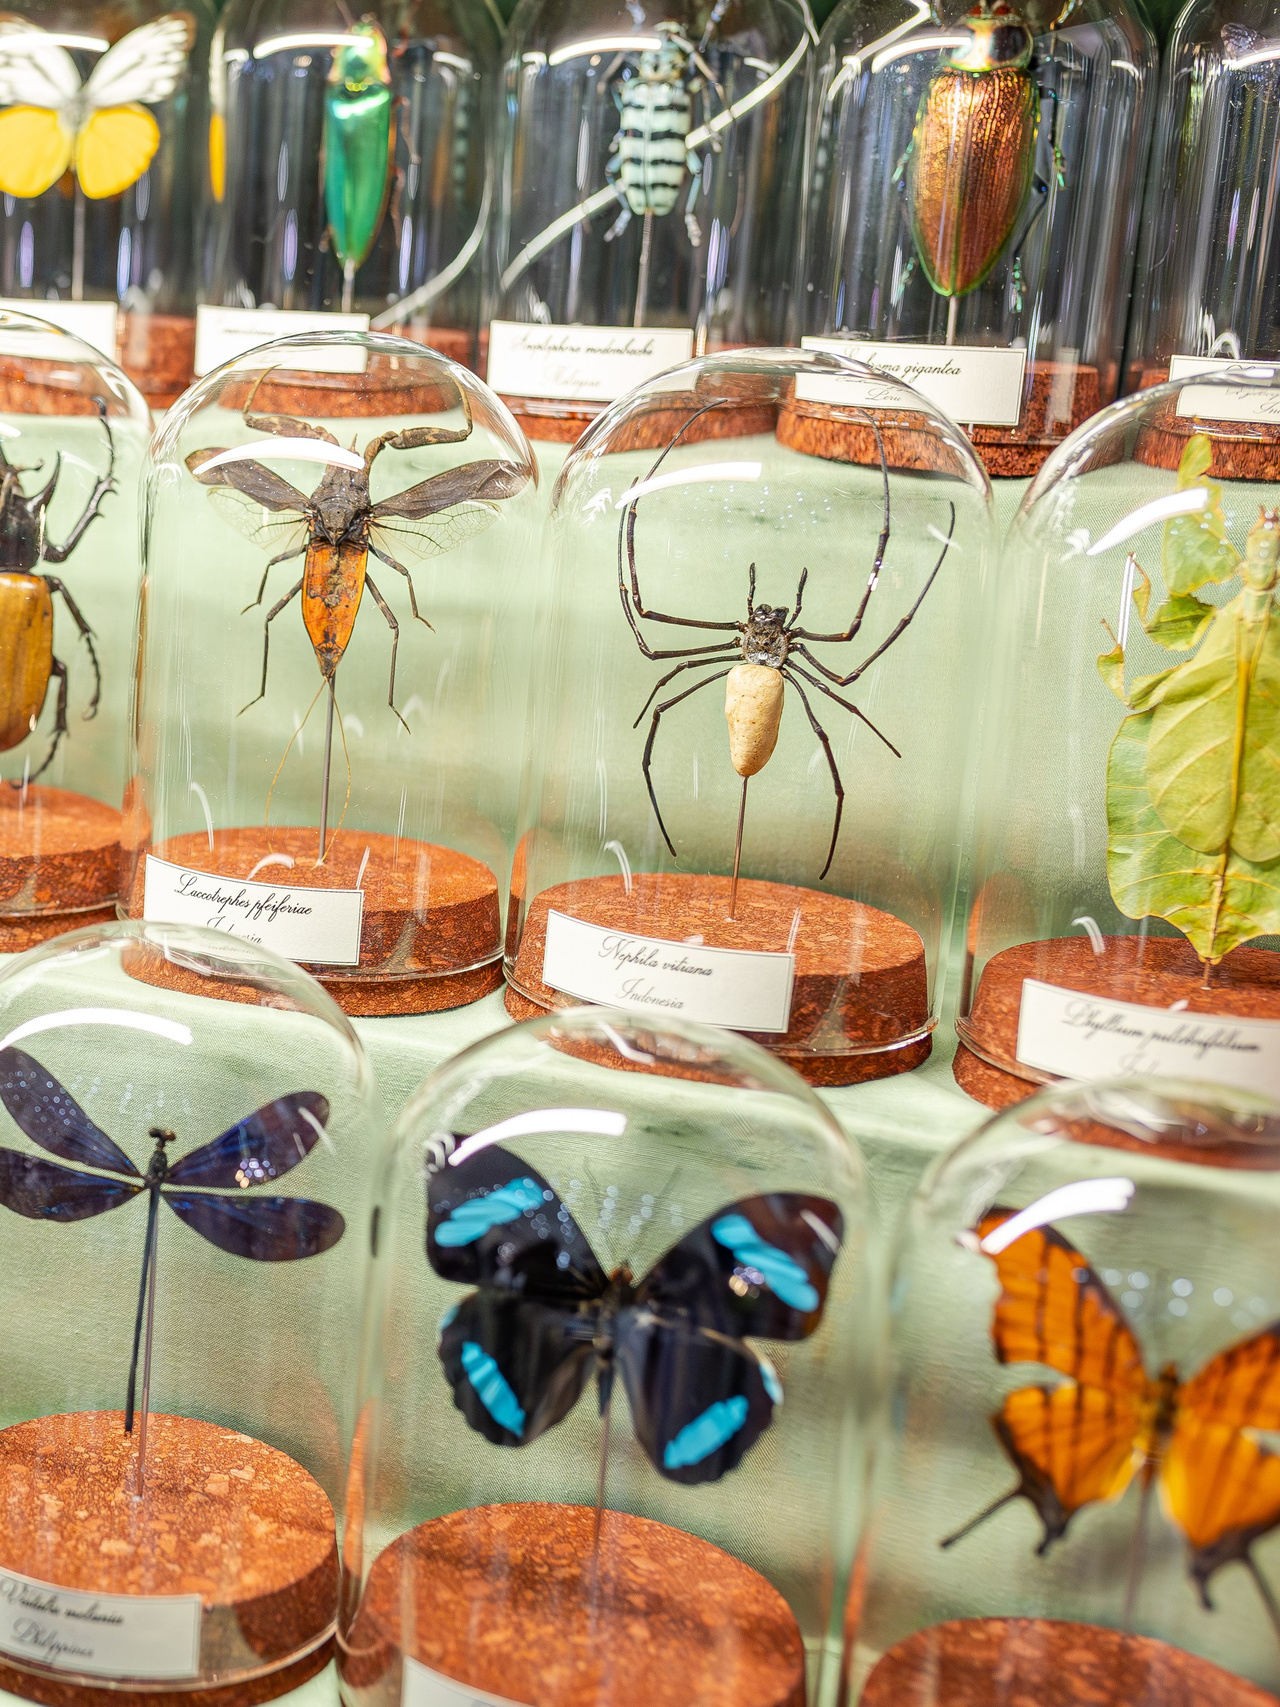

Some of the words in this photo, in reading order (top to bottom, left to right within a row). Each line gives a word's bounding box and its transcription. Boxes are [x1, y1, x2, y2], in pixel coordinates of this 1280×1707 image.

[901, 358, 962, 383] gigantea
[174, 872, 251, 914] Laccotrephes
[245, 892, 313, 922] pfeiferiae
[598, 935, 658, 970] Nephila
[662, 956, 715, 977] vitiana
[616, 977, 686, 1010] Indonesia
